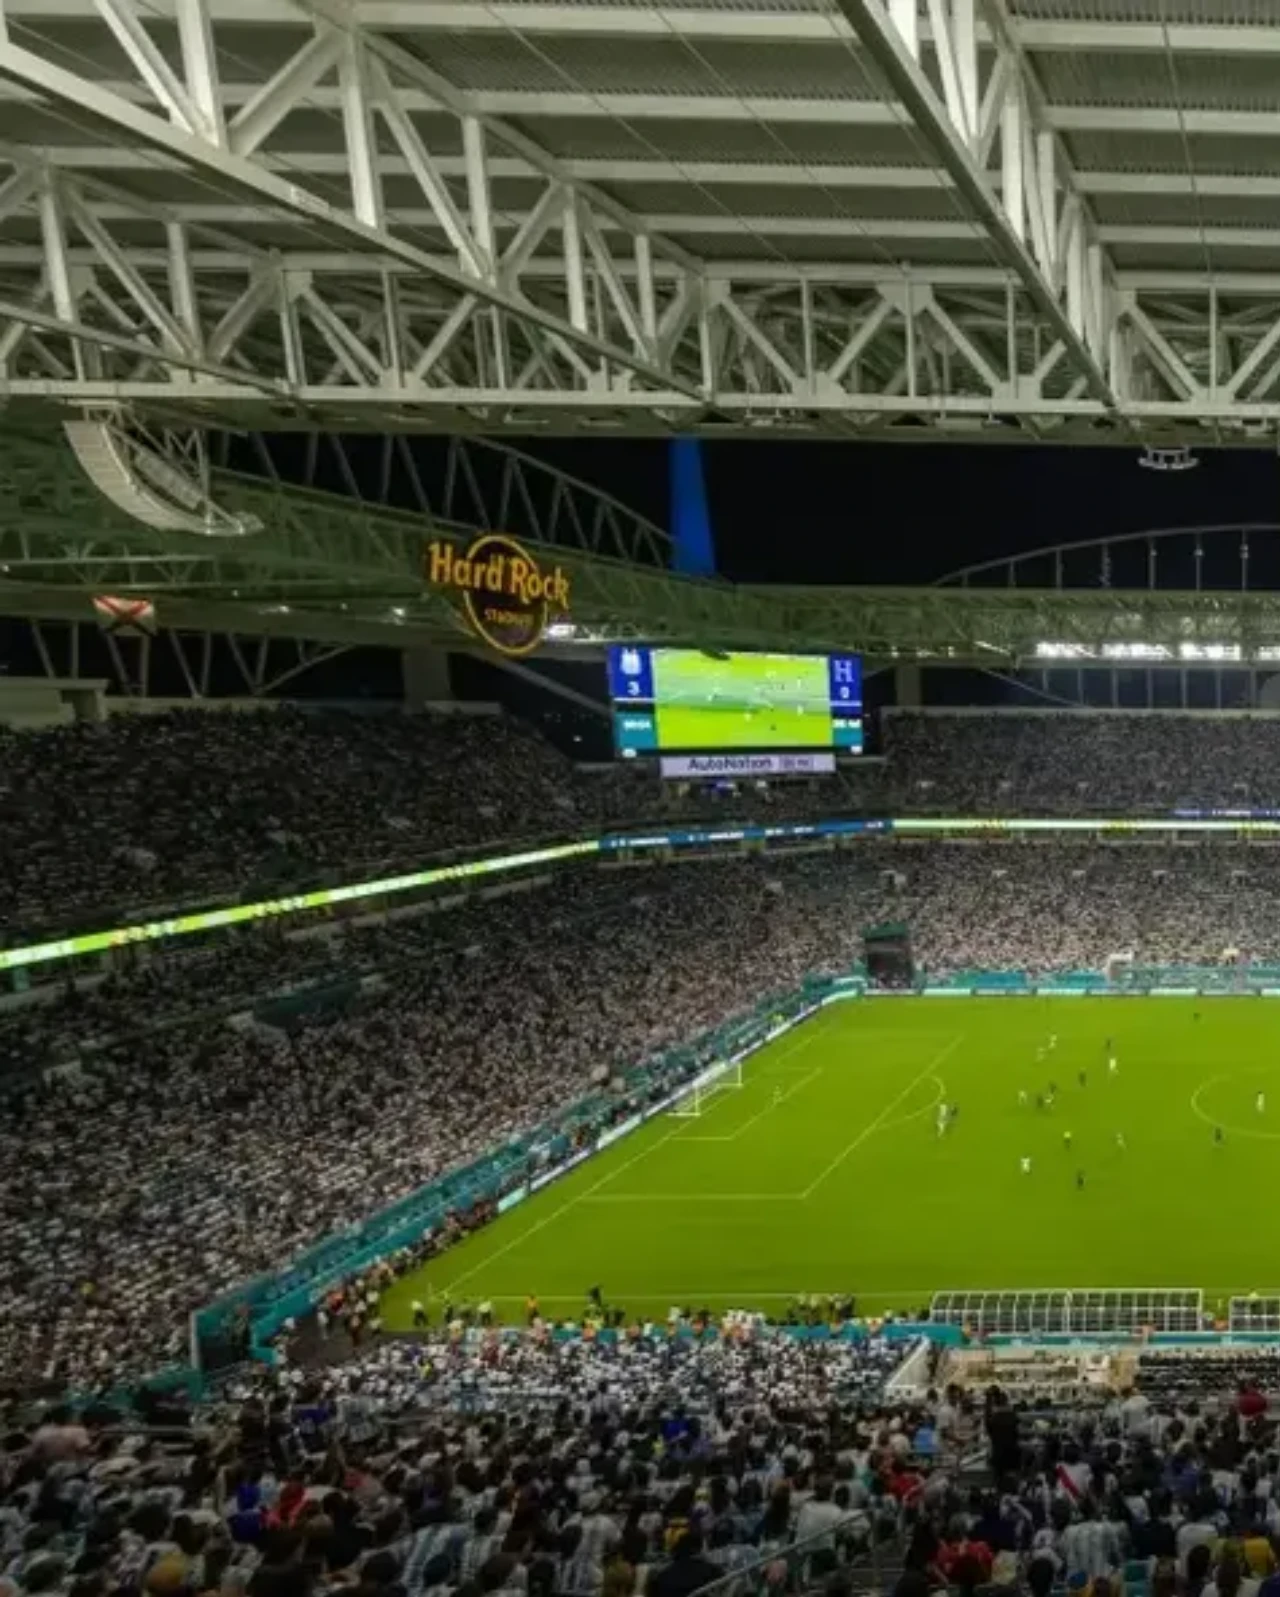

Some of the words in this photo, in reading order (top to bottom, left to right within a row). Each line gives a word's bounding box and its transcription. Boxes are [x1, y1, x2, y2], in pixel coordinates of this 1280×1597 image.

[428, 542, 504, 590] Hard
[510, 556, 570, 610] Rock
[687, 756, 773, 771] AutoNation
